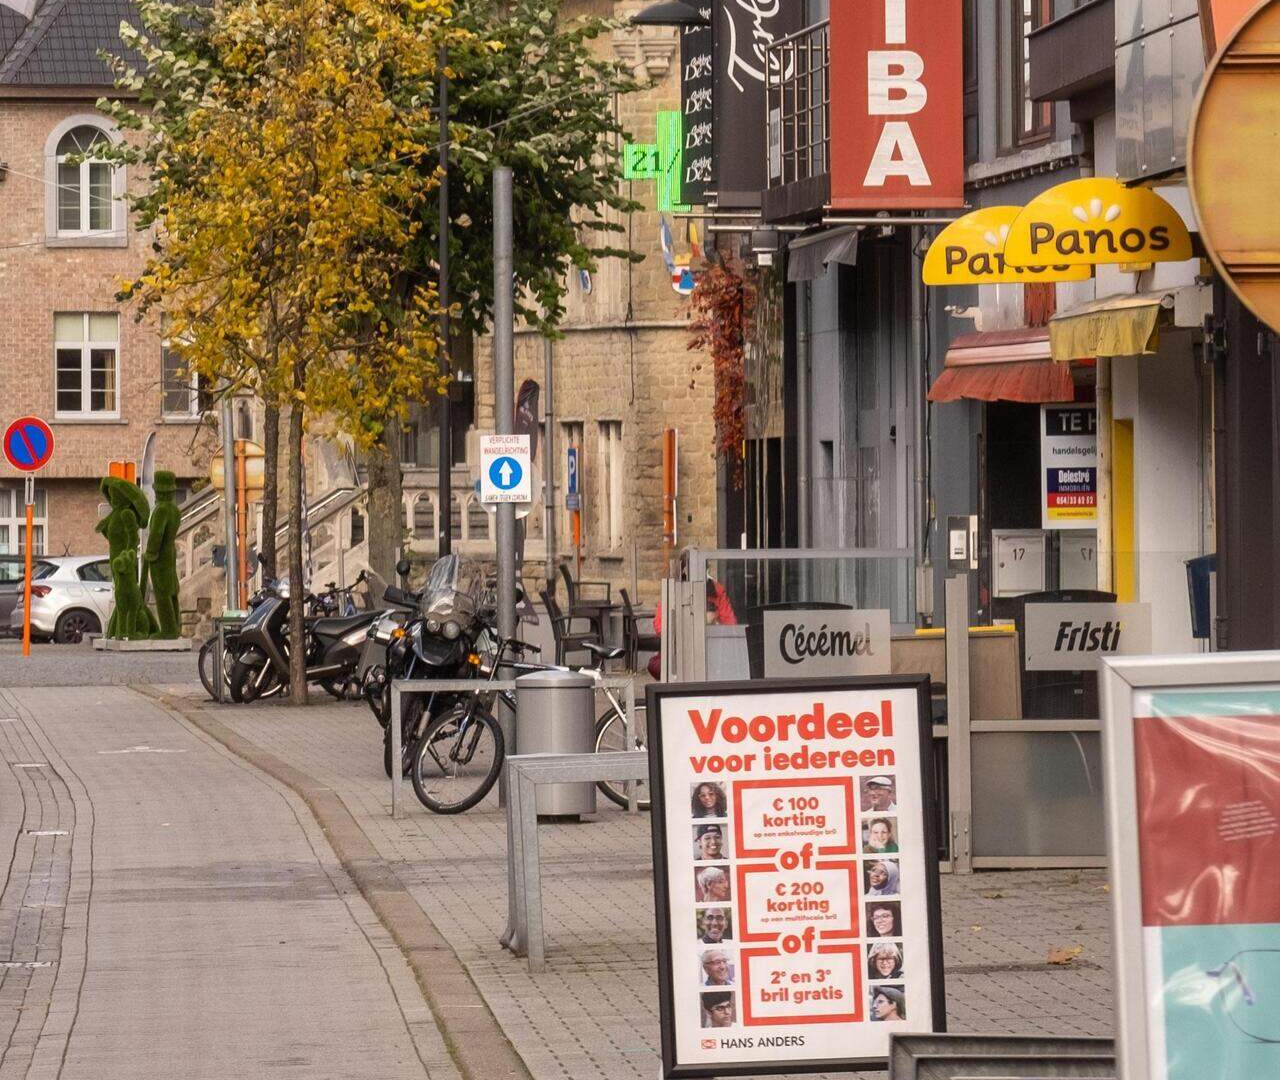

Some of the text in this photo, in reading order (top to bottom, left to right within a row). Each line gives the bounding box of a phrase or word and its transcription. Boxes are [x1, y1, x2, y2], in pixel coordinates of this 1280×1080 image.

[633, 149, 681, 173] 21/
[1030, 222, 1170, 255] Panos
[1059, 412, 1082, 432] TE
[1058, 470, 1090, 483] Delestré
[1012, 548, 1025, 560] 17
[779, 622, 874, 664] Cécémel
[688, 700, 894, 744] Voordeel
[690, 745, 895, 773] voor iedereen
[773, 797, 819, 811] € 100
[763, 813, 826, 828] korting
[780, 842, 813, 870] of
[775, 881, 824, 896] € 200
[767, 897, 829, 913] korting
[782, 926, 815, 954] of
[791, 973, 811, 983] en
[761, 986, 844, 1004] bril gratis
[721, 1036, 805, 1049] HANS ANDERS
